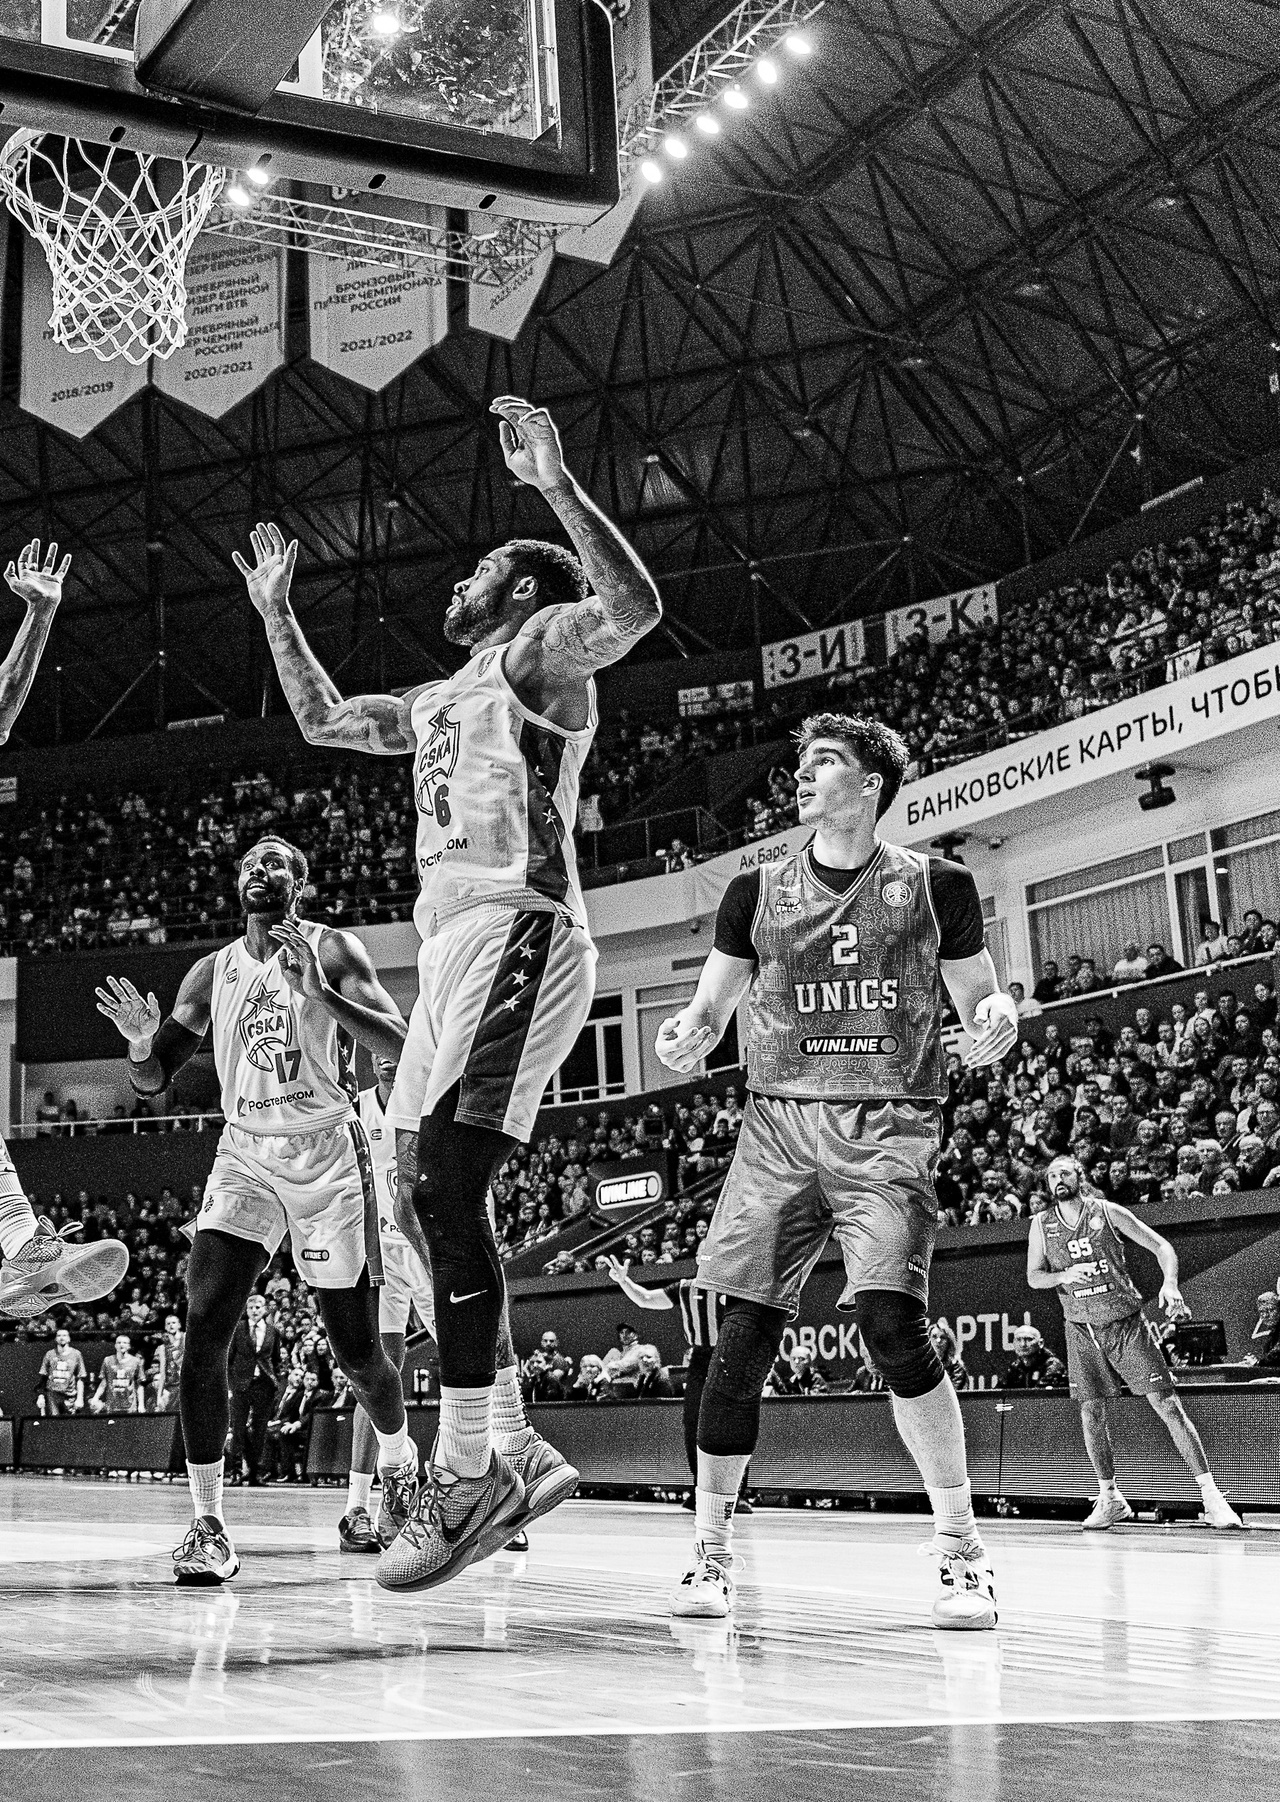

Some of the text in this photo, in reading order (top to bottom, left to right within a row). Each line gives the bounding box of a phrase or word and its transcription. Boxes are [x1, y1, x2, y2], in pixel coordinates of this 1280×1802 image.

[219, 282, 269, 301] ЕДИНОЙ
[335, 271, 416, 294] БРОНЗОВЫЙ
[358, 276, 443, 301] ЧЕМПИОНАТА
[191, 298, 249, 317] ЛИГИ ВТБ
[350, 294, 402, 314] РОССИИ
[188, 315, 259, 336] ЕРЕБРЯНЫЙ
[195, 341, 243, 357] РОССИИ
[339, 329, 413, 353] 2021/2022
[184, 360, 253, 382] 2020/2021
[50, 381, 115, 403] 2018/2019
[419, 735, 451, 774] CSKA
[906, 744, 1072, 827] БАНКОВСКИЕ
[1078, 706, 1184, 764] КАРТЫ,
[434, 783, 451, 829] 6
[740, 843, 788, 871] Ак Барс
[829, 922, 860, 967] 2
[793, 976, 901, 1015] UNICS
[248, 1015, 286, 1039] CSKA
[805, 1038, 879, 1054] WINLINE
[274, 1049, 302, 1085] 17
[247, 1090, 315, 1112] Ростелеком
[599, 1178, 648, 1206] WINLINE
[1067, 1237, 1093, 1260] 95
